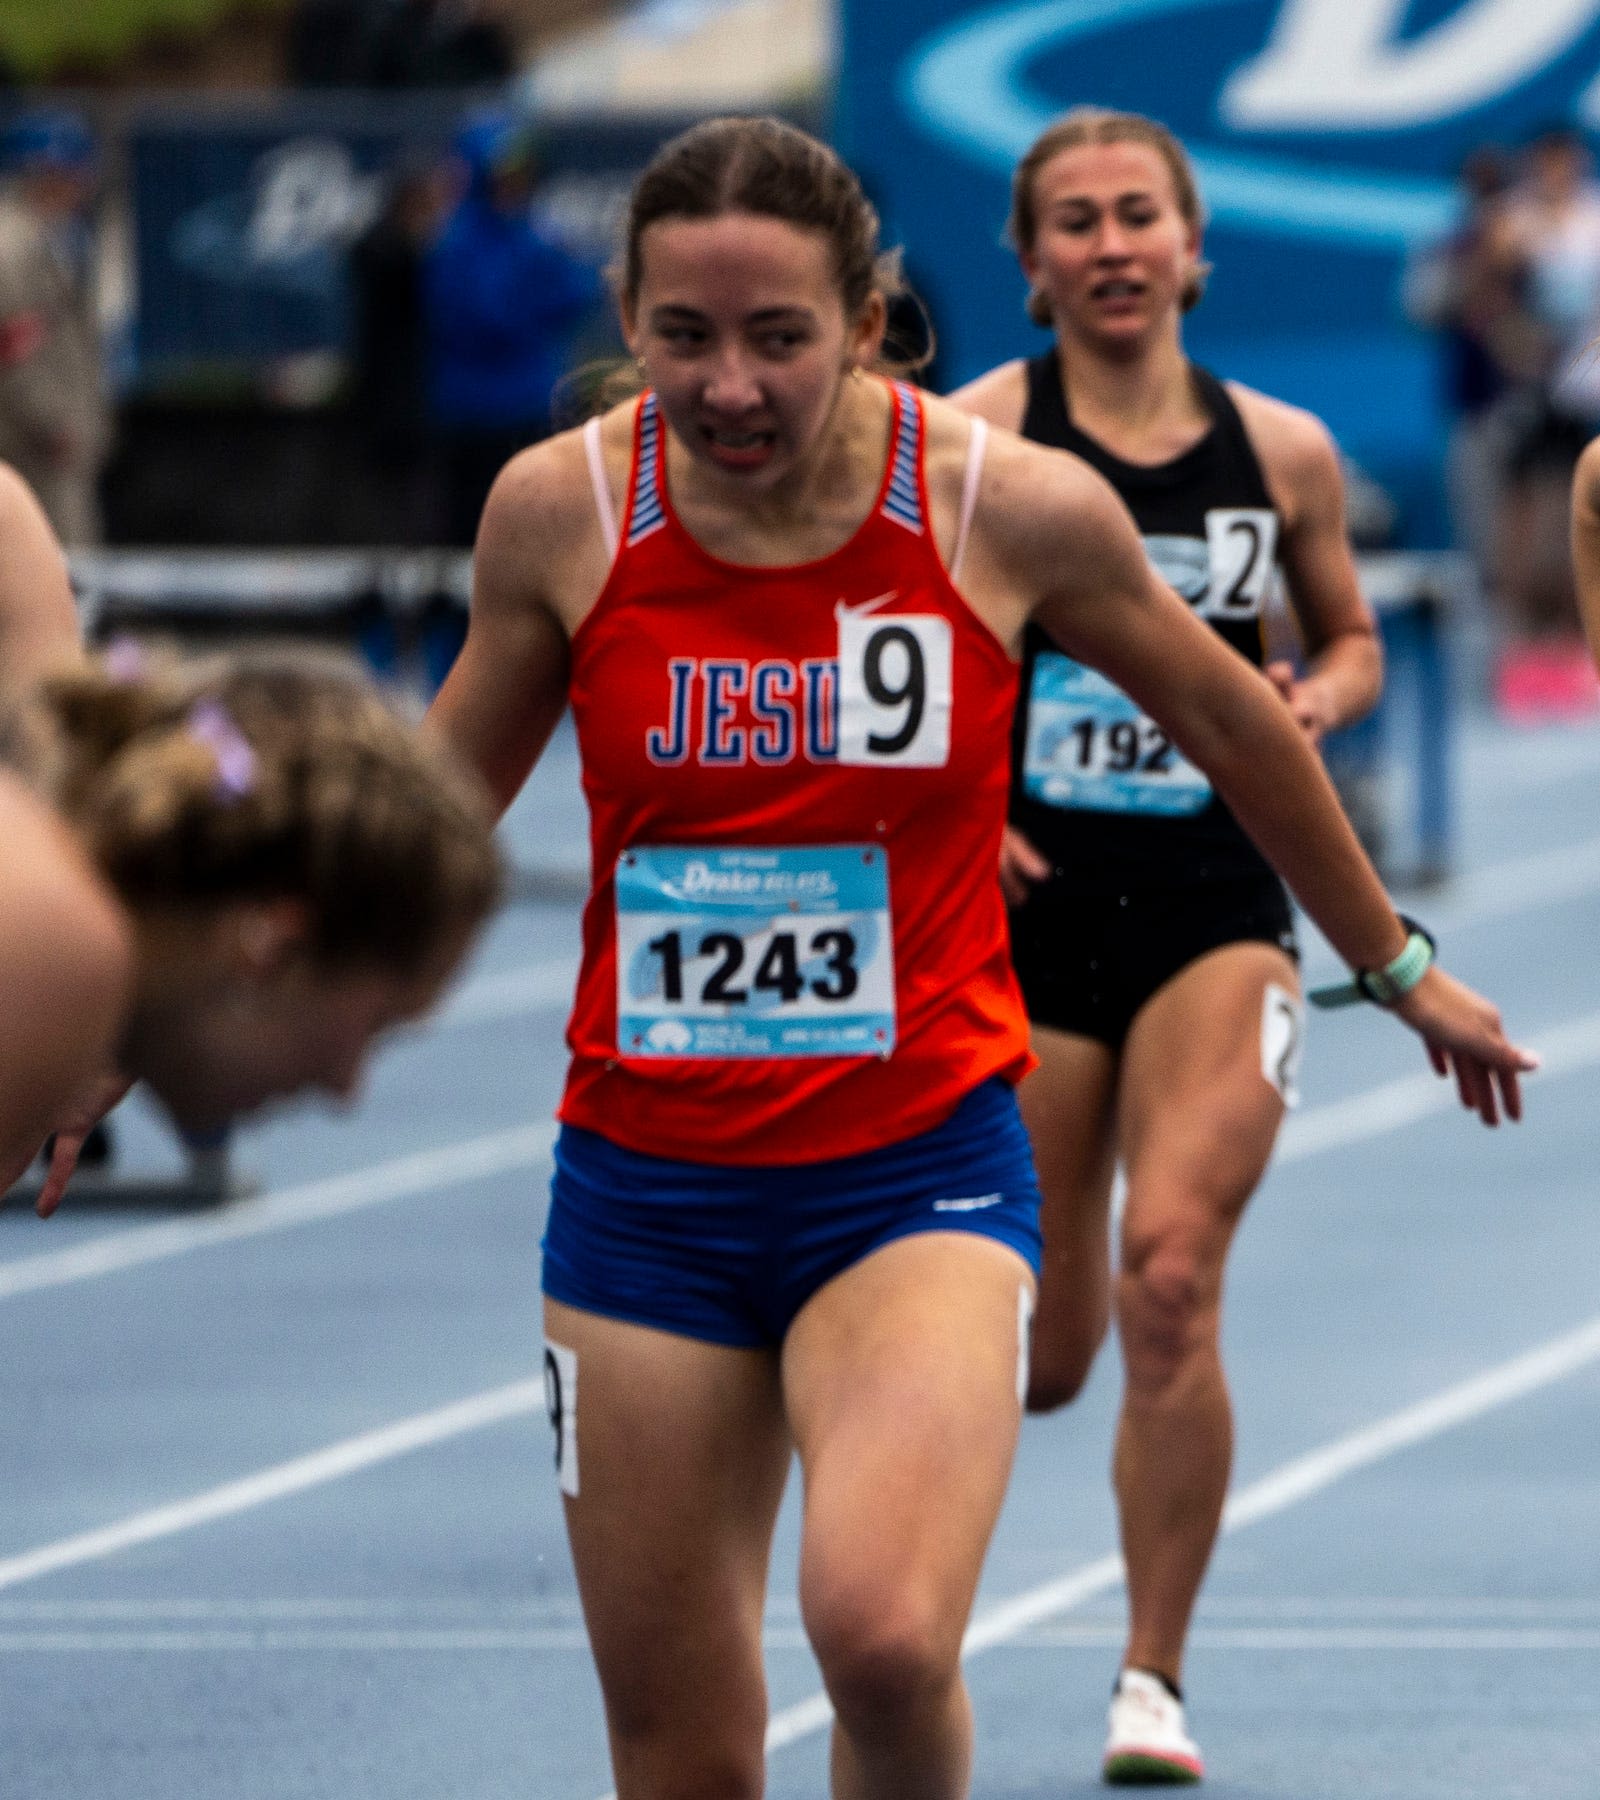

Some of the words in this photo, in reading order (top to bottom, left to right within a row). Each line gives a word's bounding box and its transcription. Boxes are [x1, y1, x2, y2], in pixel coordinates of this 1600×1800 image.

[1225, 520, 1258, 607] 2
[646, 656, 840, 768] JESU
[863, 625, 926, 755] 9
[649, 931, 859, 1004] 1243
